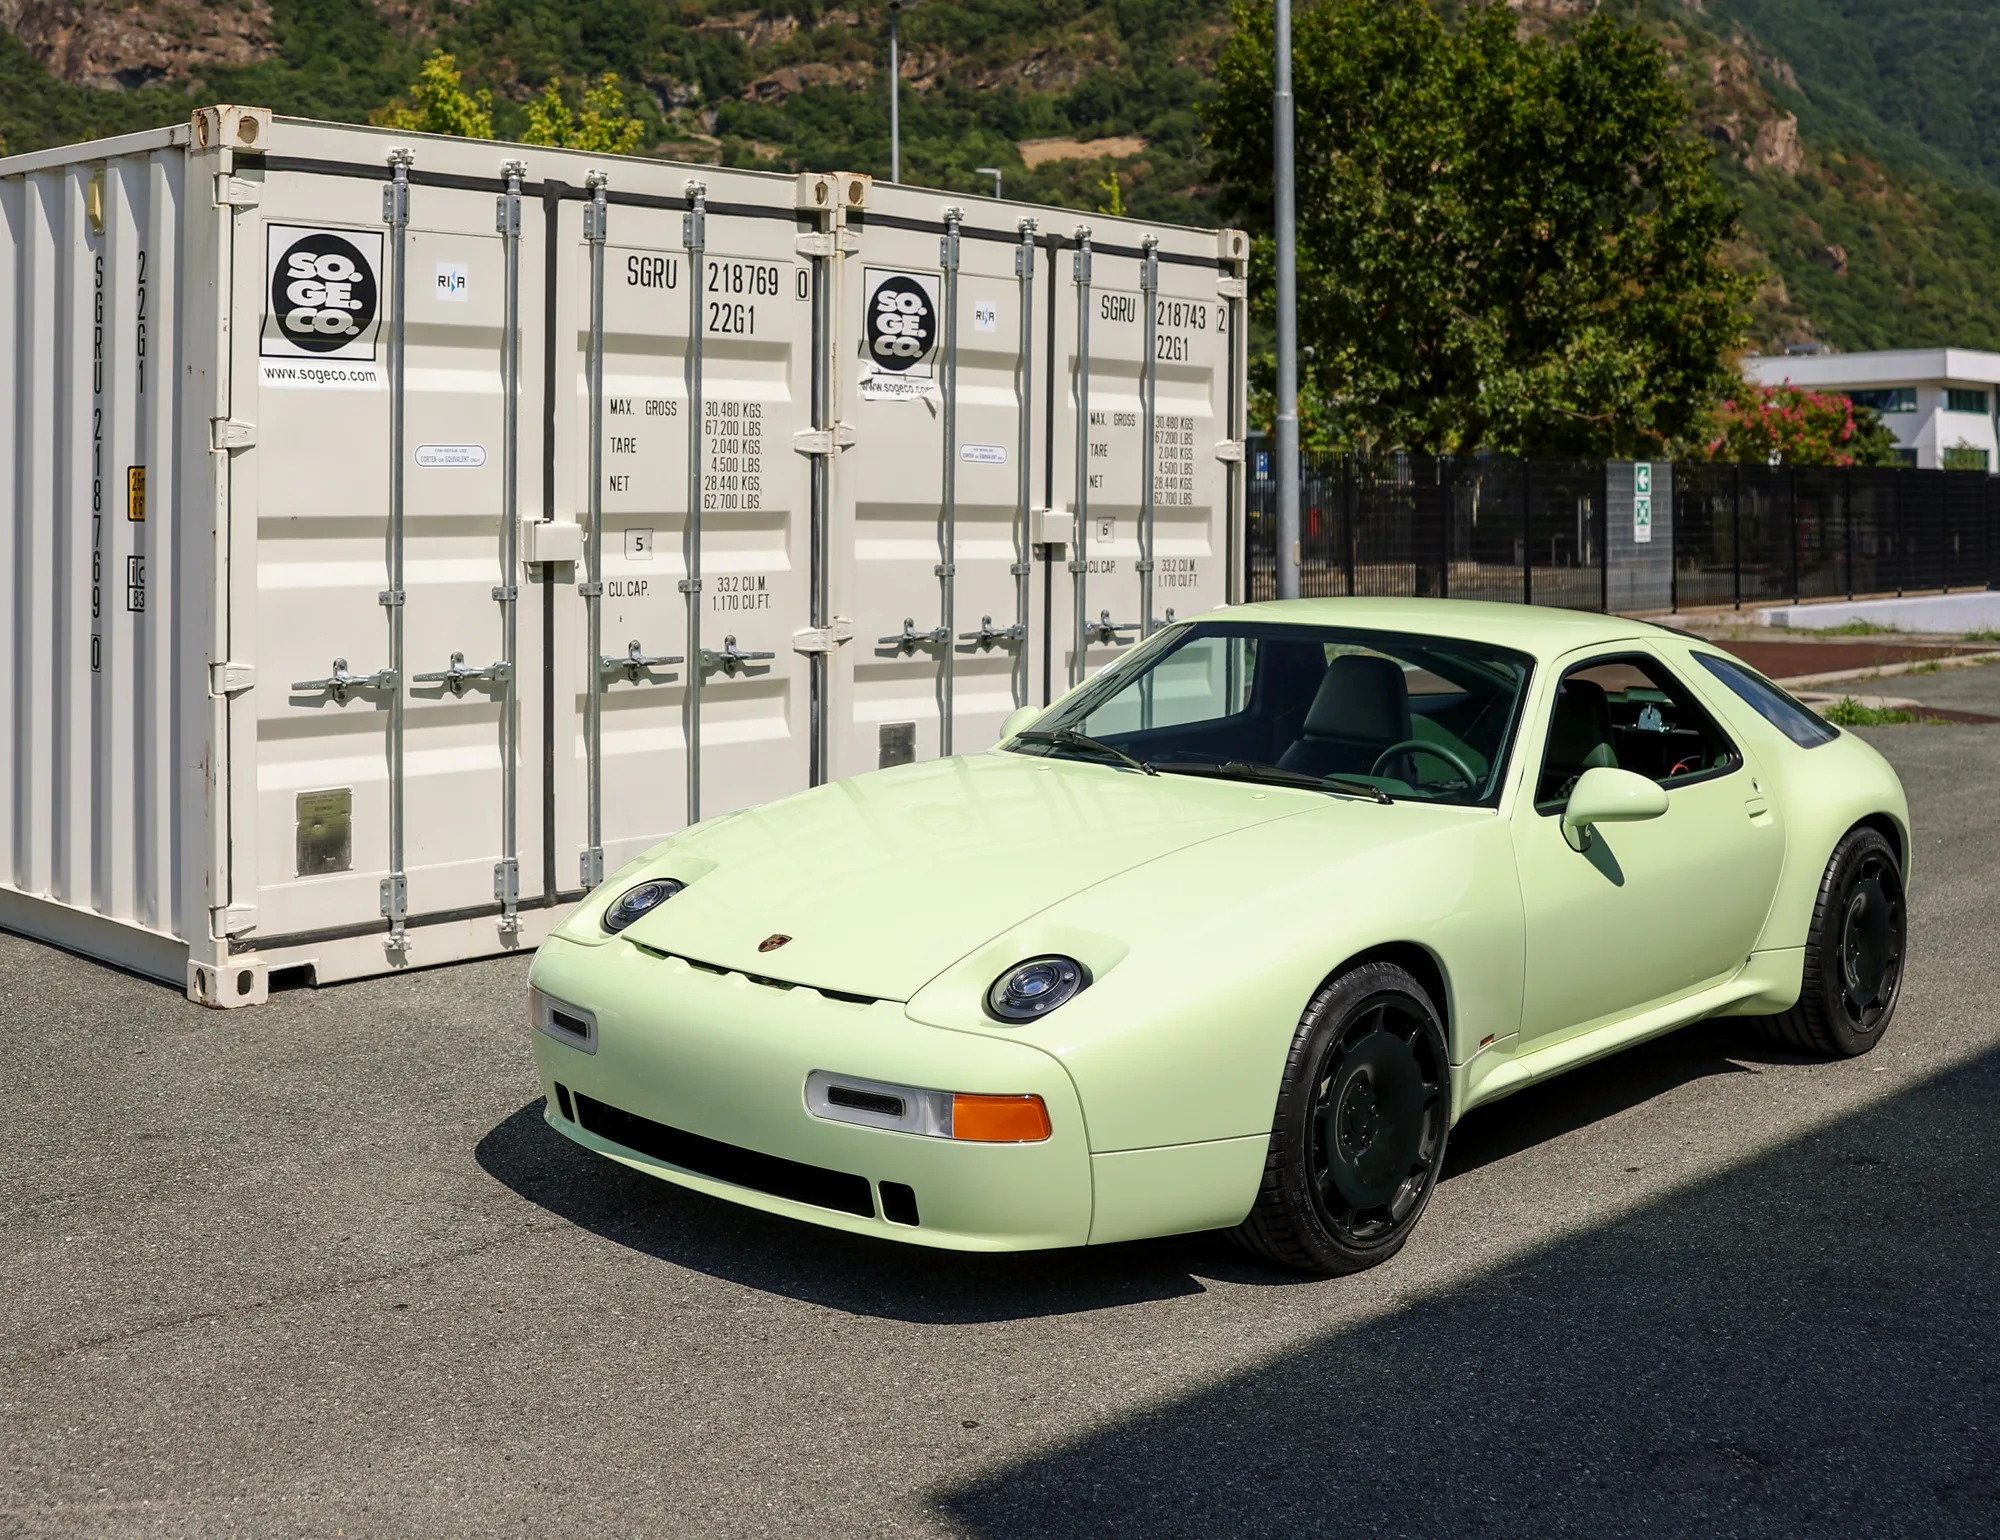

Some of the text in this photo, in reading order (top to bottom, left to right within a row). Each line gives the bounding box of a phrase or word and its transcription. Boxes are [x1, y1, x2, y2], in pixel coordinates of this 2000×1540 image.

[287, 252, 363, 283] SO.
[627, 256, 807, 298] SGRU 218769 0
[286, 280, 363, 310] GE.
[877, 290, 927, 316] SO.
[138, 251, 146, 393] 22G1
[285, 308, 360, 335] CO.
[709, 302, 755, 334] 22G1
[1101, 295, 1225, 331] SGRU 218743 2
[876, 313, 927, 338] GE.
[874, 335, 923, 358] CO.
[1157, 335, 1188, 361] 22G1
[264, 366, 377, 383] www.sogeco.com
[610, 399, 635, 415] MAX.
[645, 400, 677, 416] GROSS
[743, 403, 763, 418] KGS.
[743, 422, 763, 437] LBS.
[1114, 414, 1135, 427] GROSS
[611, 438, 636, 453] TARE
[742, 440, 762, 455] KGS.
[1091, 444, 1108, 457] TARE
[742, 458, 762, 473] LBS.
[609, 476, 630, 492] NET
[742, 476, 762, 491] KGS.
[1090, 475, 1103, 488] NET
[741, 495, 762, 509] LBS.
[92, 408, 101, 619] 218769
[1102, 524, 1108, 536] 6
[635, 537, 643, 551] 5
[717, 577, 739, 592] 33.2
